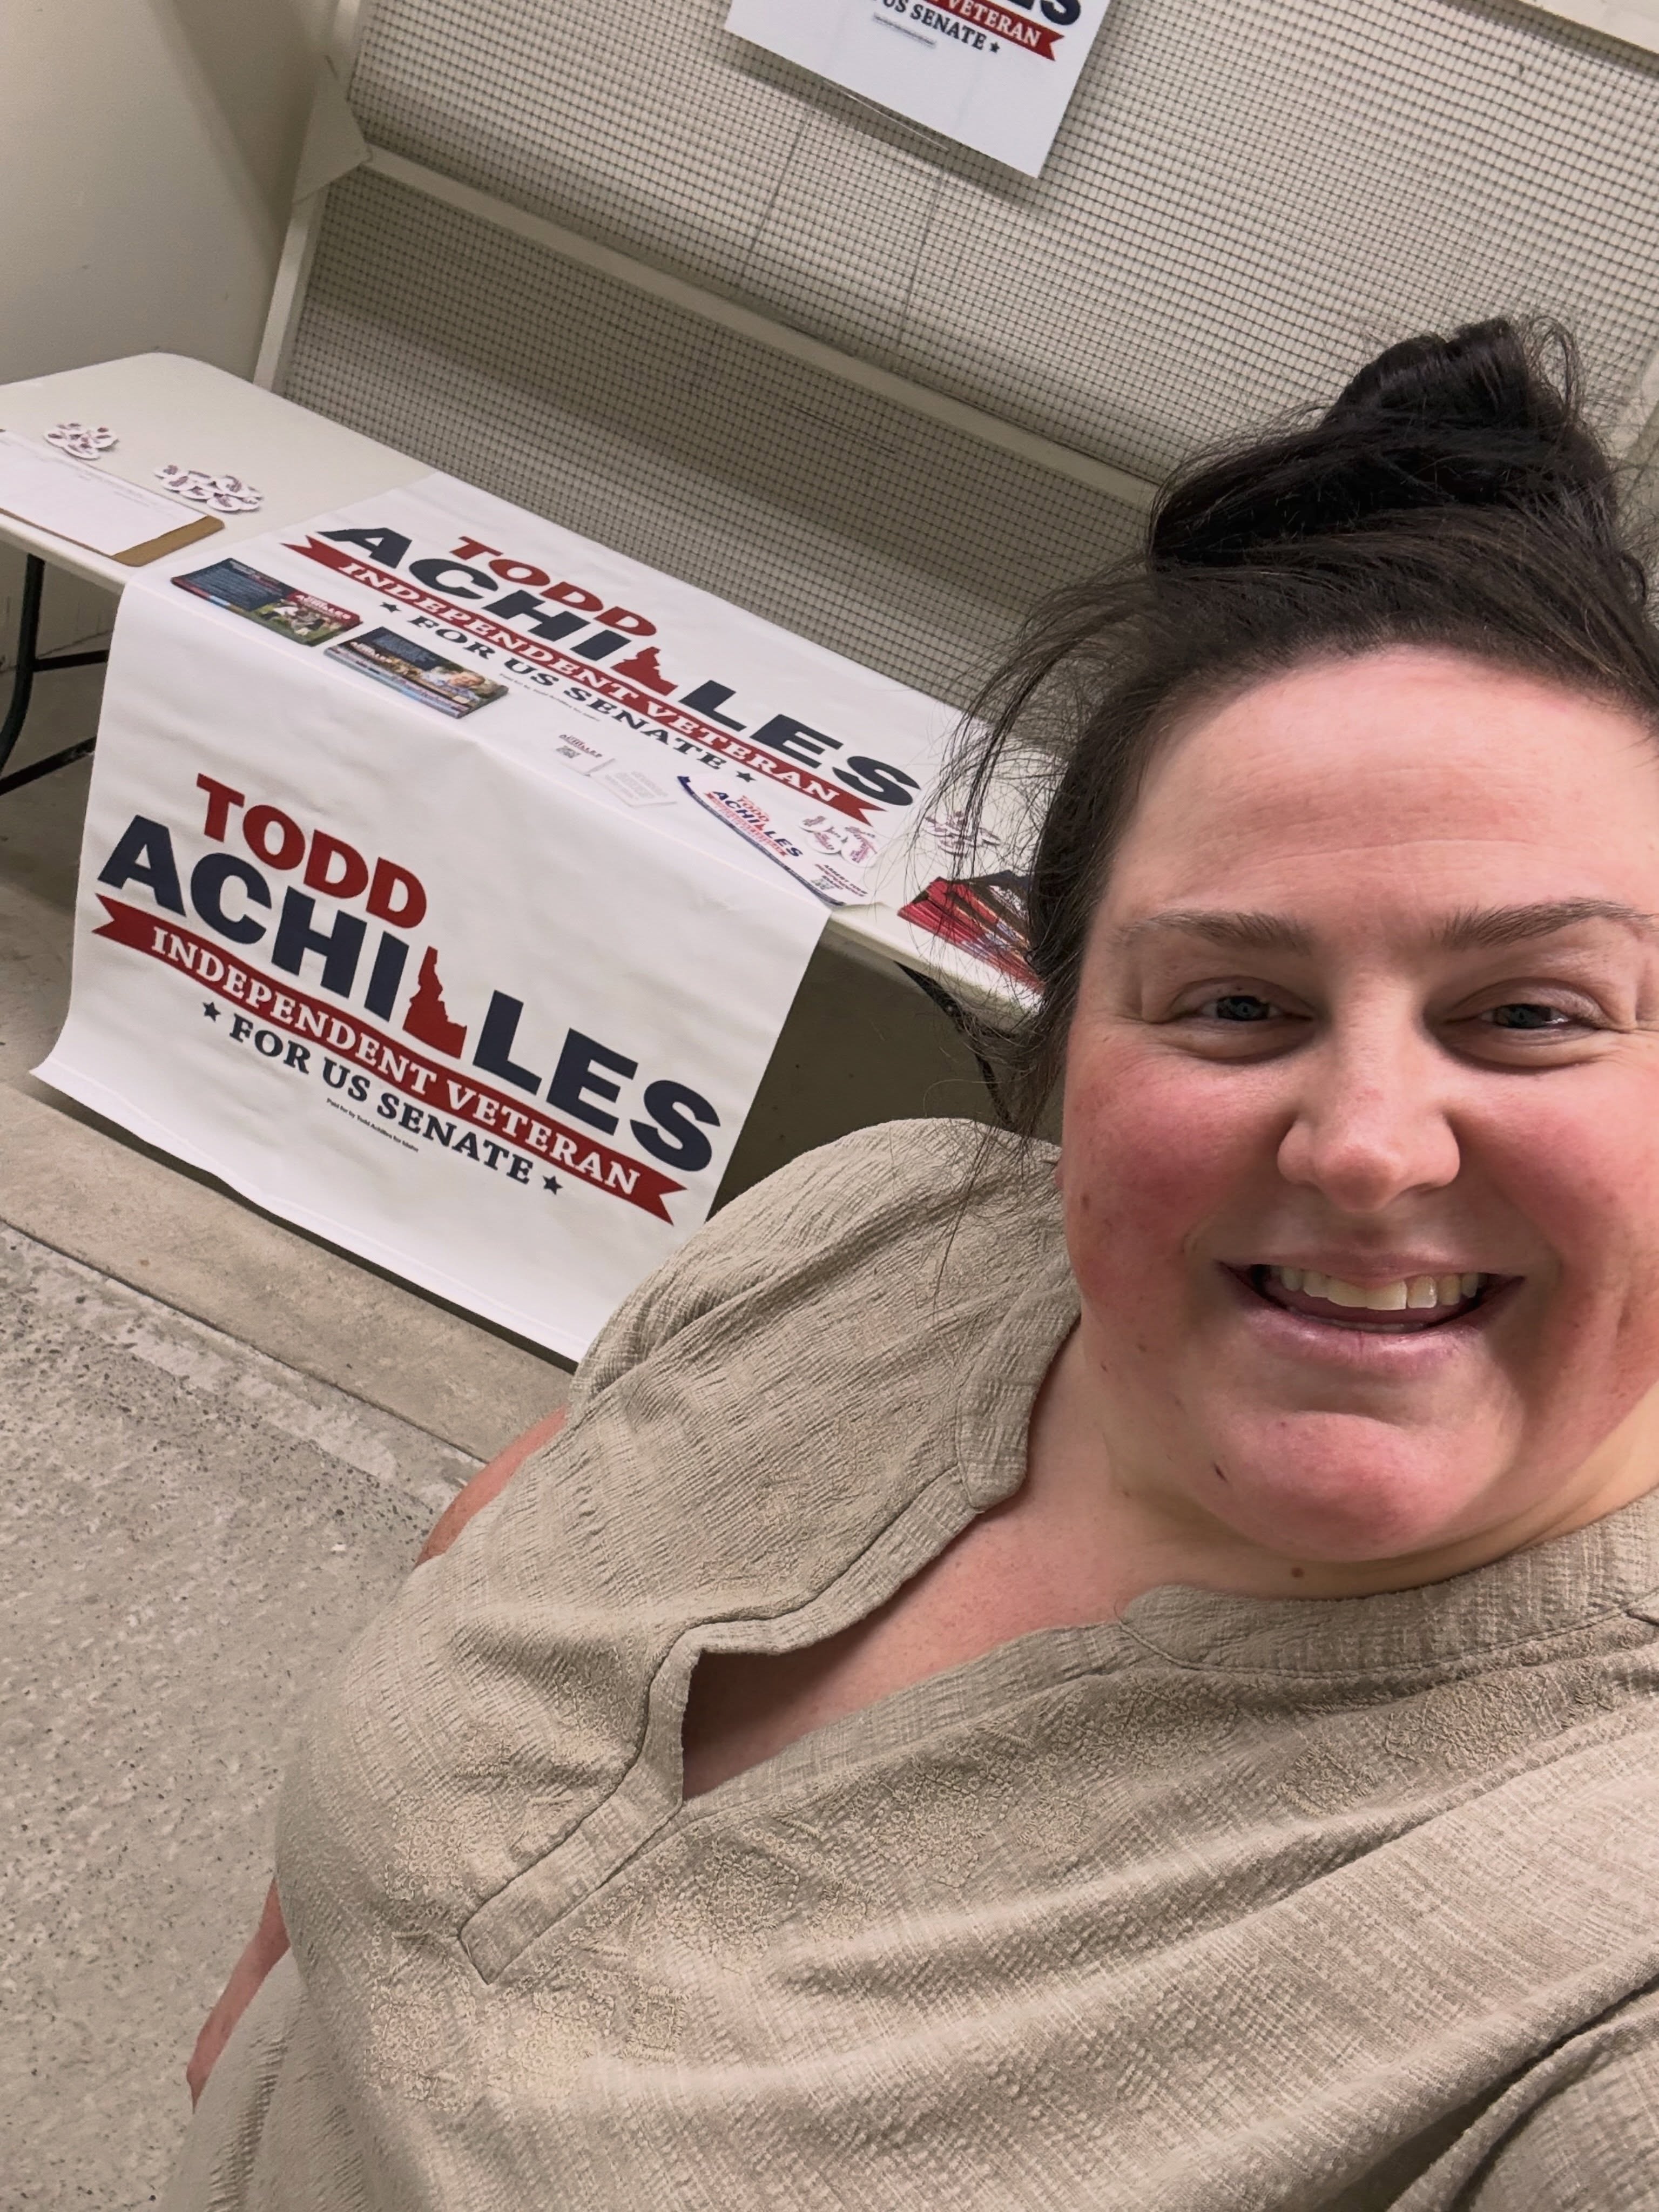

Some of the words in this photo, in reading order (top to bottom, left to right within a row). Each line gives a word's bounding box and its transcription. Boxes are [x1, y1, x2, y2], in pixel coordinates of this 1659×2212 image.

[910, 4, 987, 50] SENATE
[948, 0, 1041, 47] VETERAN
[450, 536, 657, 636] TODD
[316, 528, 920, 805] ACHILLES
[338, 562, 639, 702] INDEPENDENT
[646, 701, 840, 801] VETERAN
[408, 616, 498, 659] FOR
[504, 658, 559, 686] US
[563, 687, 727, 770] SENATE
[197, 773, 427, 928] TODD
[737, 795, 771, 822] TODD
[98, 814, 720, 1171] ACHILLES
[151, 926, 436, 1095] INDEPENDENT
[447, 1079, 640, 1195] VETERAN
[230, 1013, 311, 1074] FOR
[322, 1057, 369, 1101] US
[377, 1093, 533, 1184] SENATE
